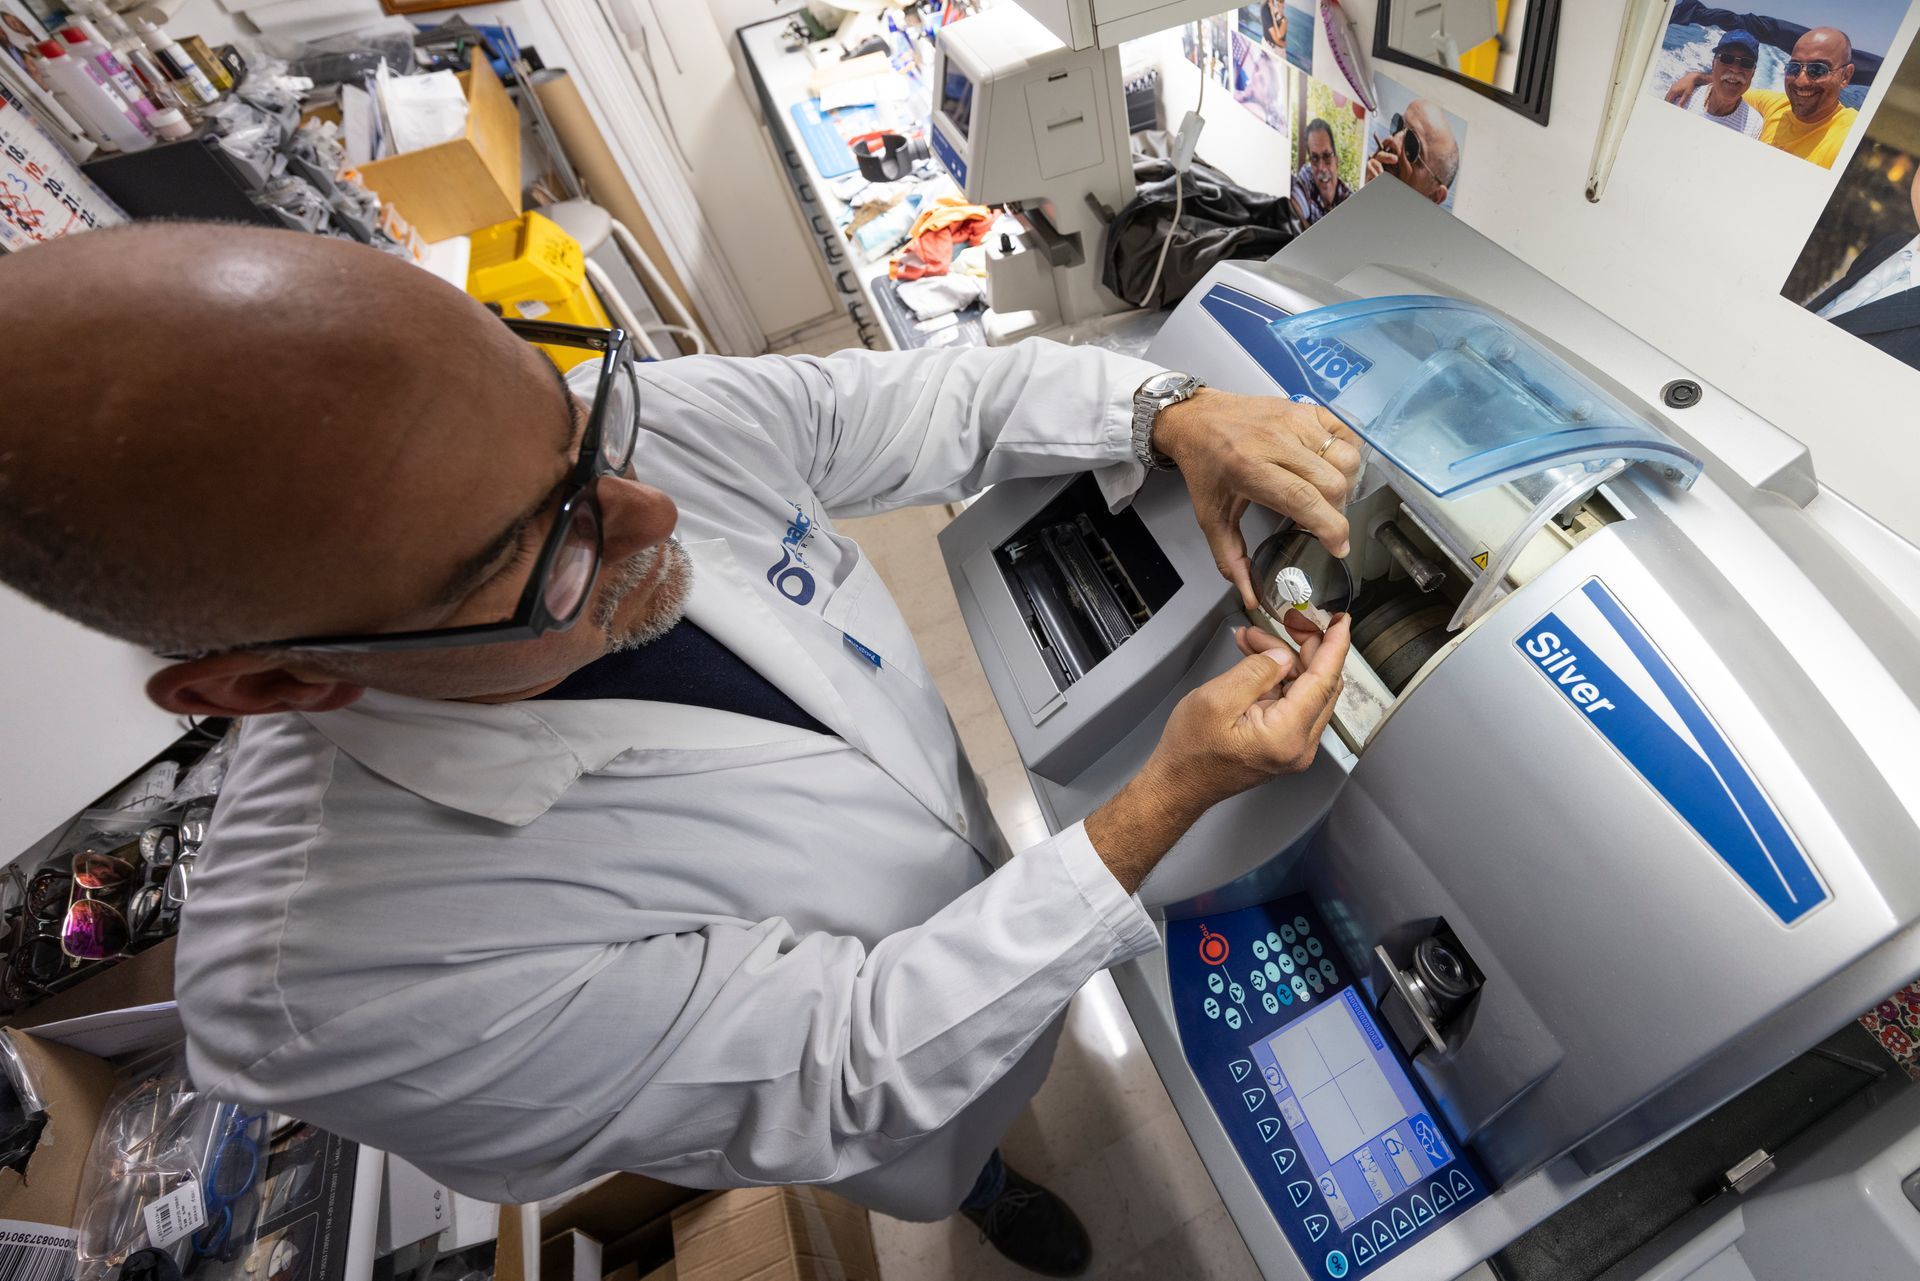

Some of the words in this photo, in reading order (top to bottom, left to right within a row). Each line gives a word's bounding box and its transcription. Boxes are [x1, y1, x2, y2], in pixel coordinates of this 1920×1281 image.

[6, 145, 25, 164] 18
[25, 161, 44, 180] 19
[43, 178, 63, 199] 20
[62, 194, 80, 215] 21
[1525, 629, 1615, 715] Silver
[1200, 923, 1211, 940] STOP
[1265, 997, 1276, 1010] CE
[1330, 1255, 1343, 1273] OK
